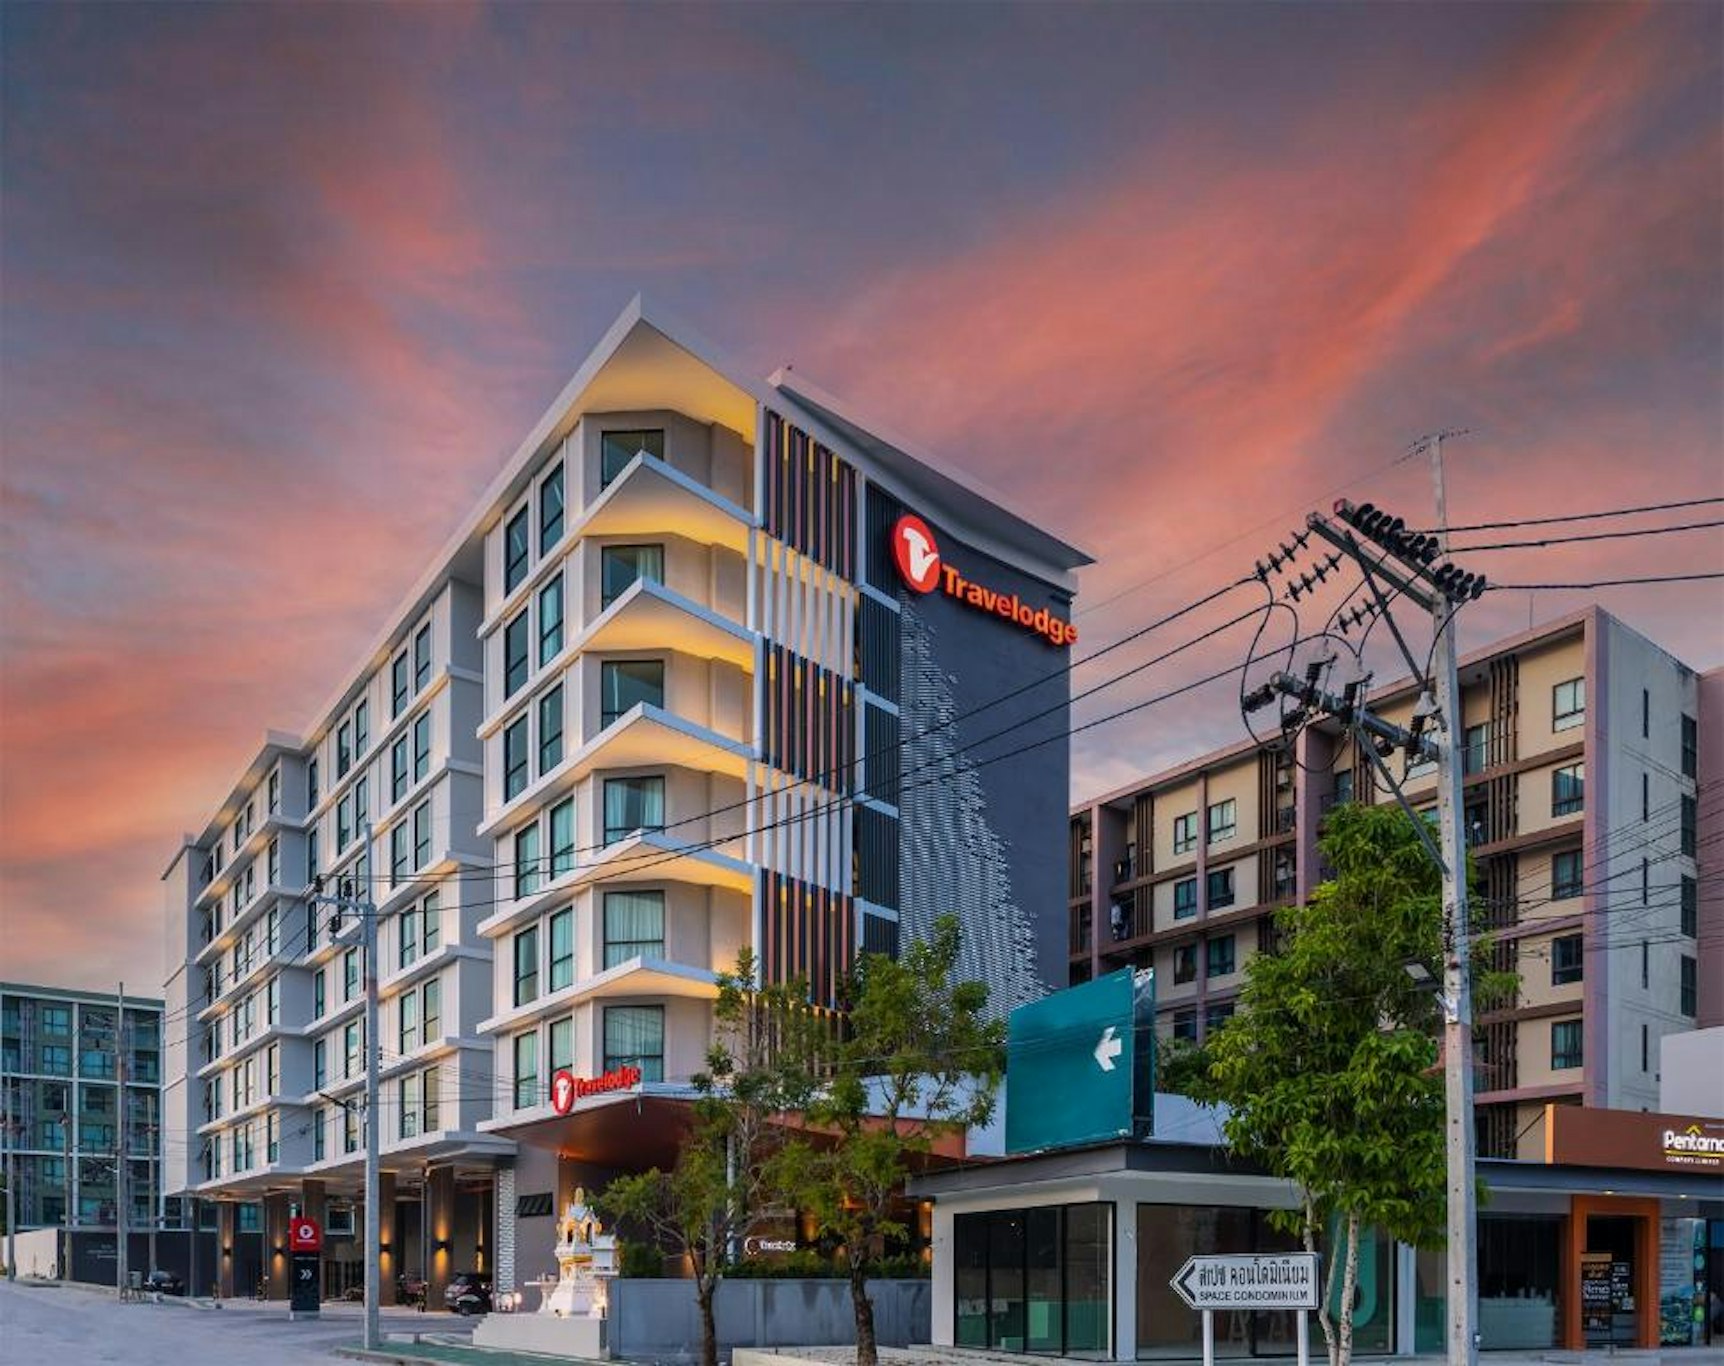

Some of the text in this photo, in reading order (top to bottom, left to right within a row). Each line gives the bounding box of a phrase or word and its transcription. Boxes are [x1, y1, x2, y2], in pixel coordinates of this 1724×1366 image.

[942, 562, 1079, 645] Travelodge
[1200, 1290, 1308, 1301] SPACE CONDOMINIUM
